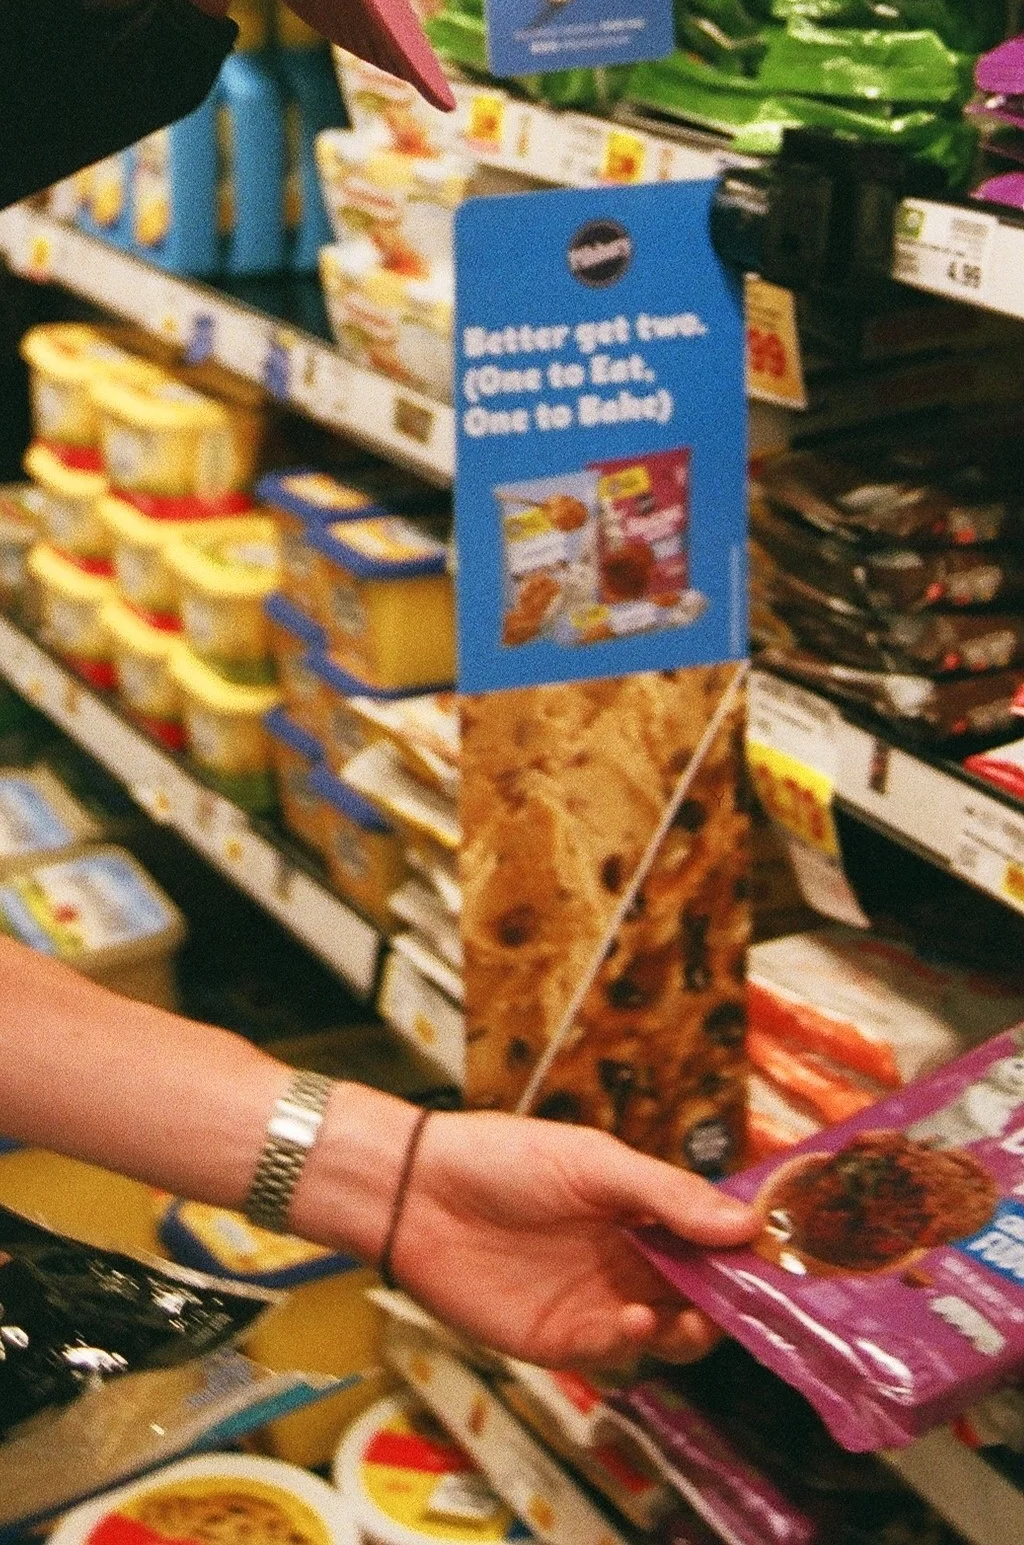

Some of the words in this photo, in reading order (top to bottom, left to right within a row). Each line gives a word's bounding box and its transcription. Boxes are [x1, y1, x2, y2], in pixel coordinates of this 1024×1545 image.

[463, 324, 570, 359] Better
[575, 315, 630, 355] get
[636, 312, 709, 341] two.
[463, 364, 543, 404] (One
[546, 361, 586, 389] to
[463, 406, 529, 438] One
[535, 401, 574, 432] to
[578, 389, 674, 427] Bake)
